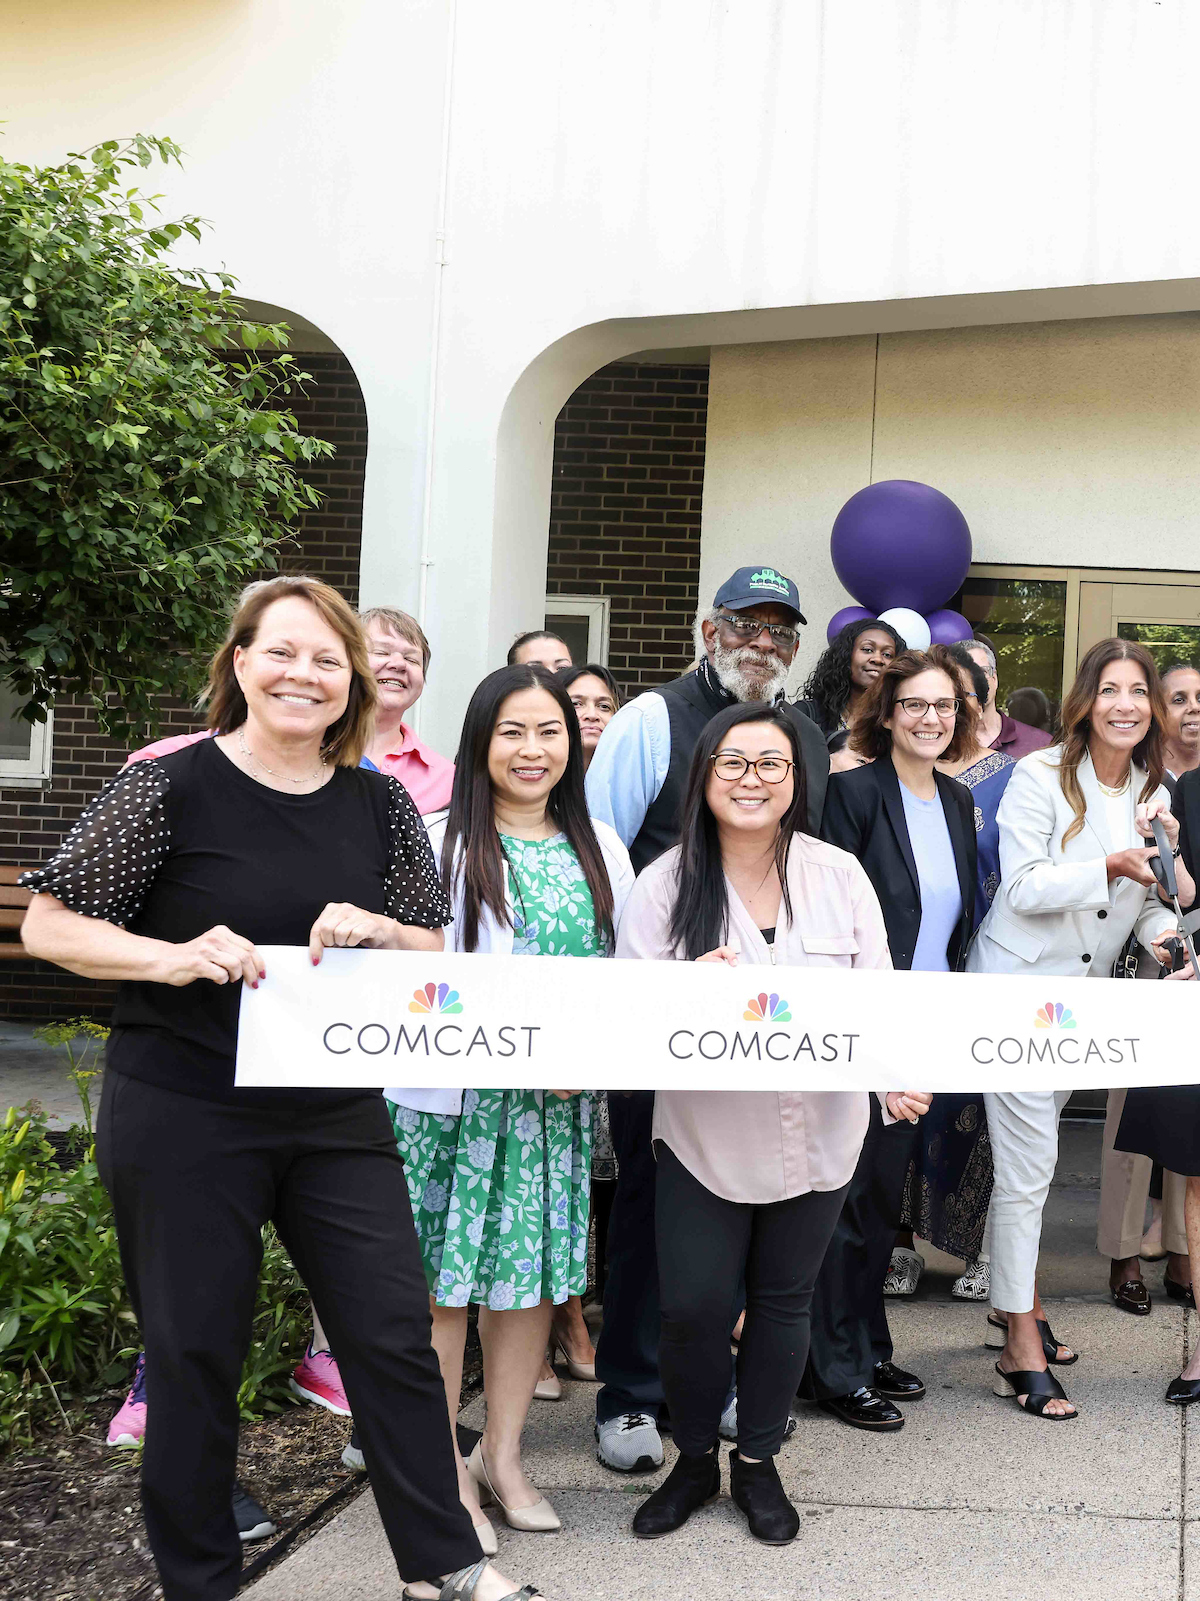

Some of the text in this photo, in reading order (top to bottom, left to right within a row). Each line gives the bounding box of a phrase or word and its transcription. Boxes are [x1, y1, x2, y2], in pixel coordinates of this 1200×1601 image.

[323, 1023, 541, 1057] COMCAST
[669, 1030, 860, 1062] COMCAST
[971, 1037, 1140, 1064] COMCAST
